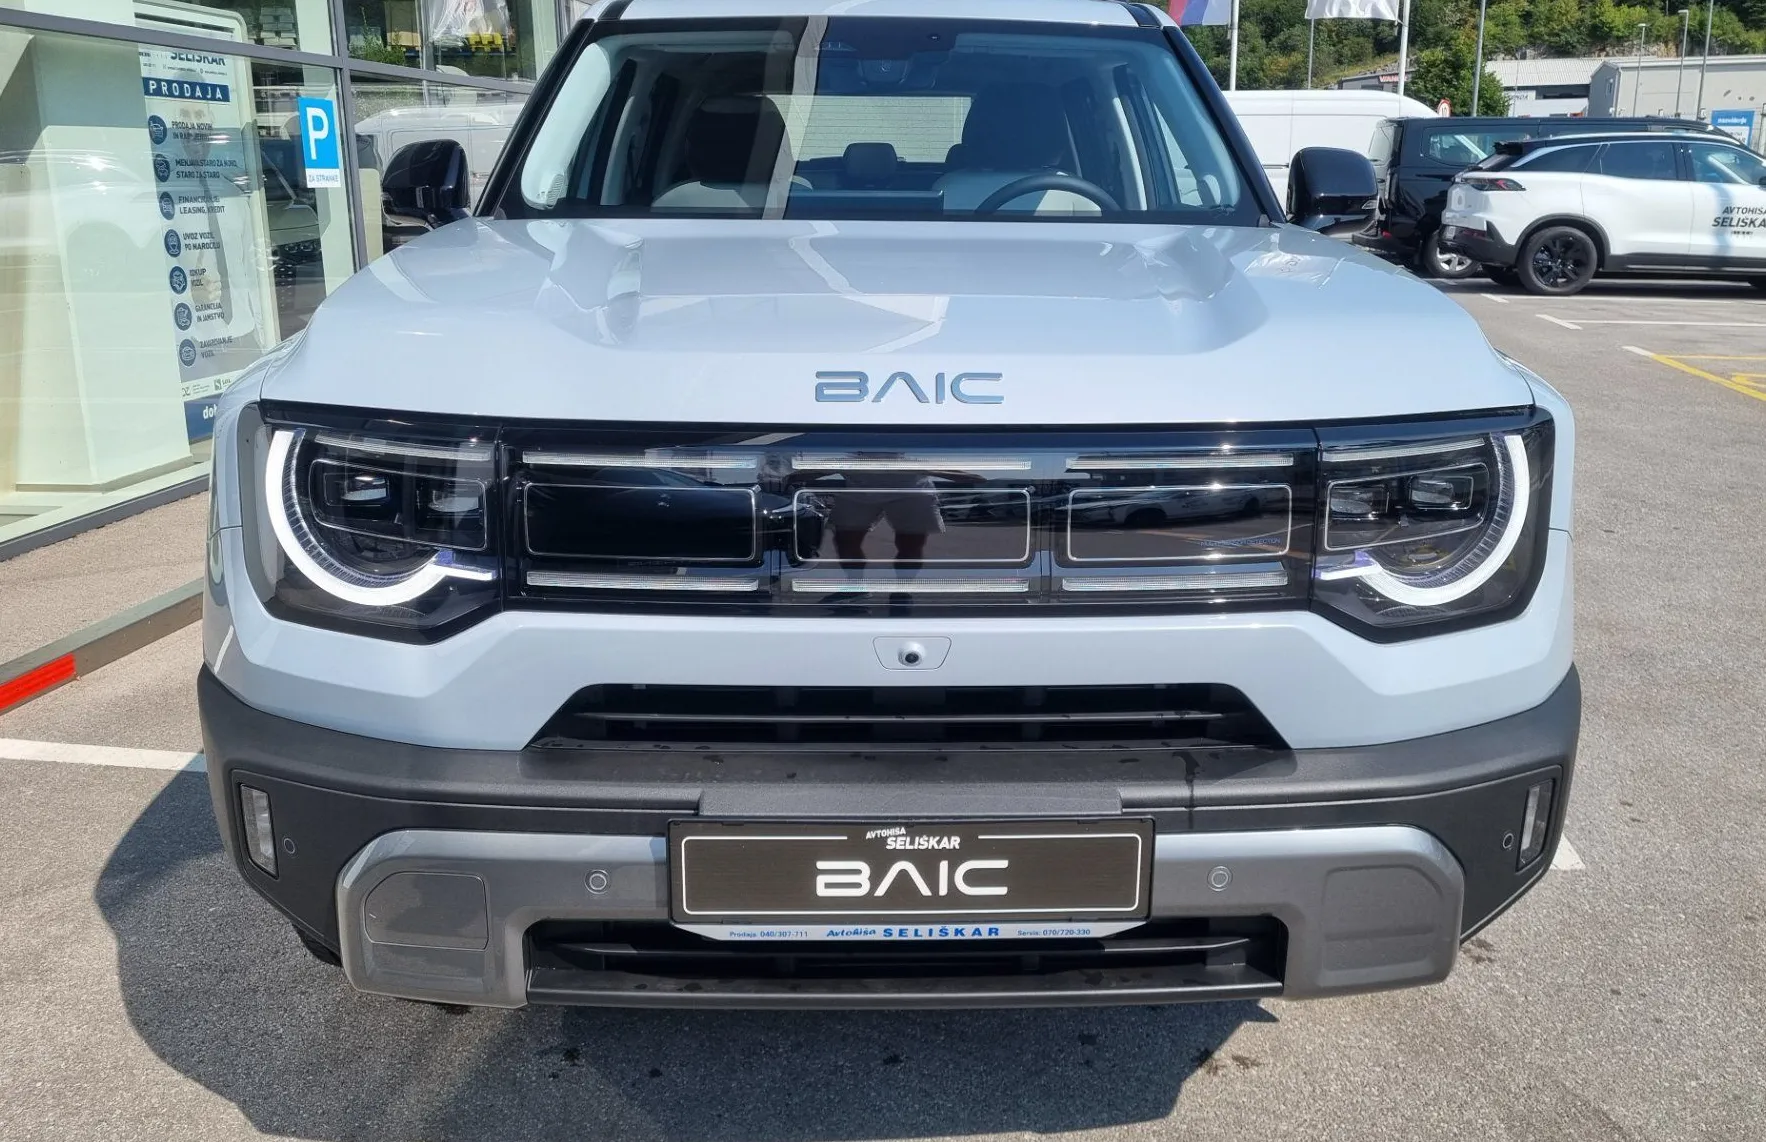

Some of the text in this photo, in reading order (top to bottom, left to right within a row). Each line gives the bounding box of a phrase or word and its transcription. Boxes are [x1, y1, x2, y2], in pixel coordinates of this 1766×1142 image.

[149, 80, 223, 100] PRODAJA
[306, 106, 329, 160] P
[815, 371, 1004, 404] BAIC
[886, 834, 960, 850] SELIŠKAR
[816, 859, 1009, 897] BAIC
[882, 925, 1000, 938] SELIŠKAR
